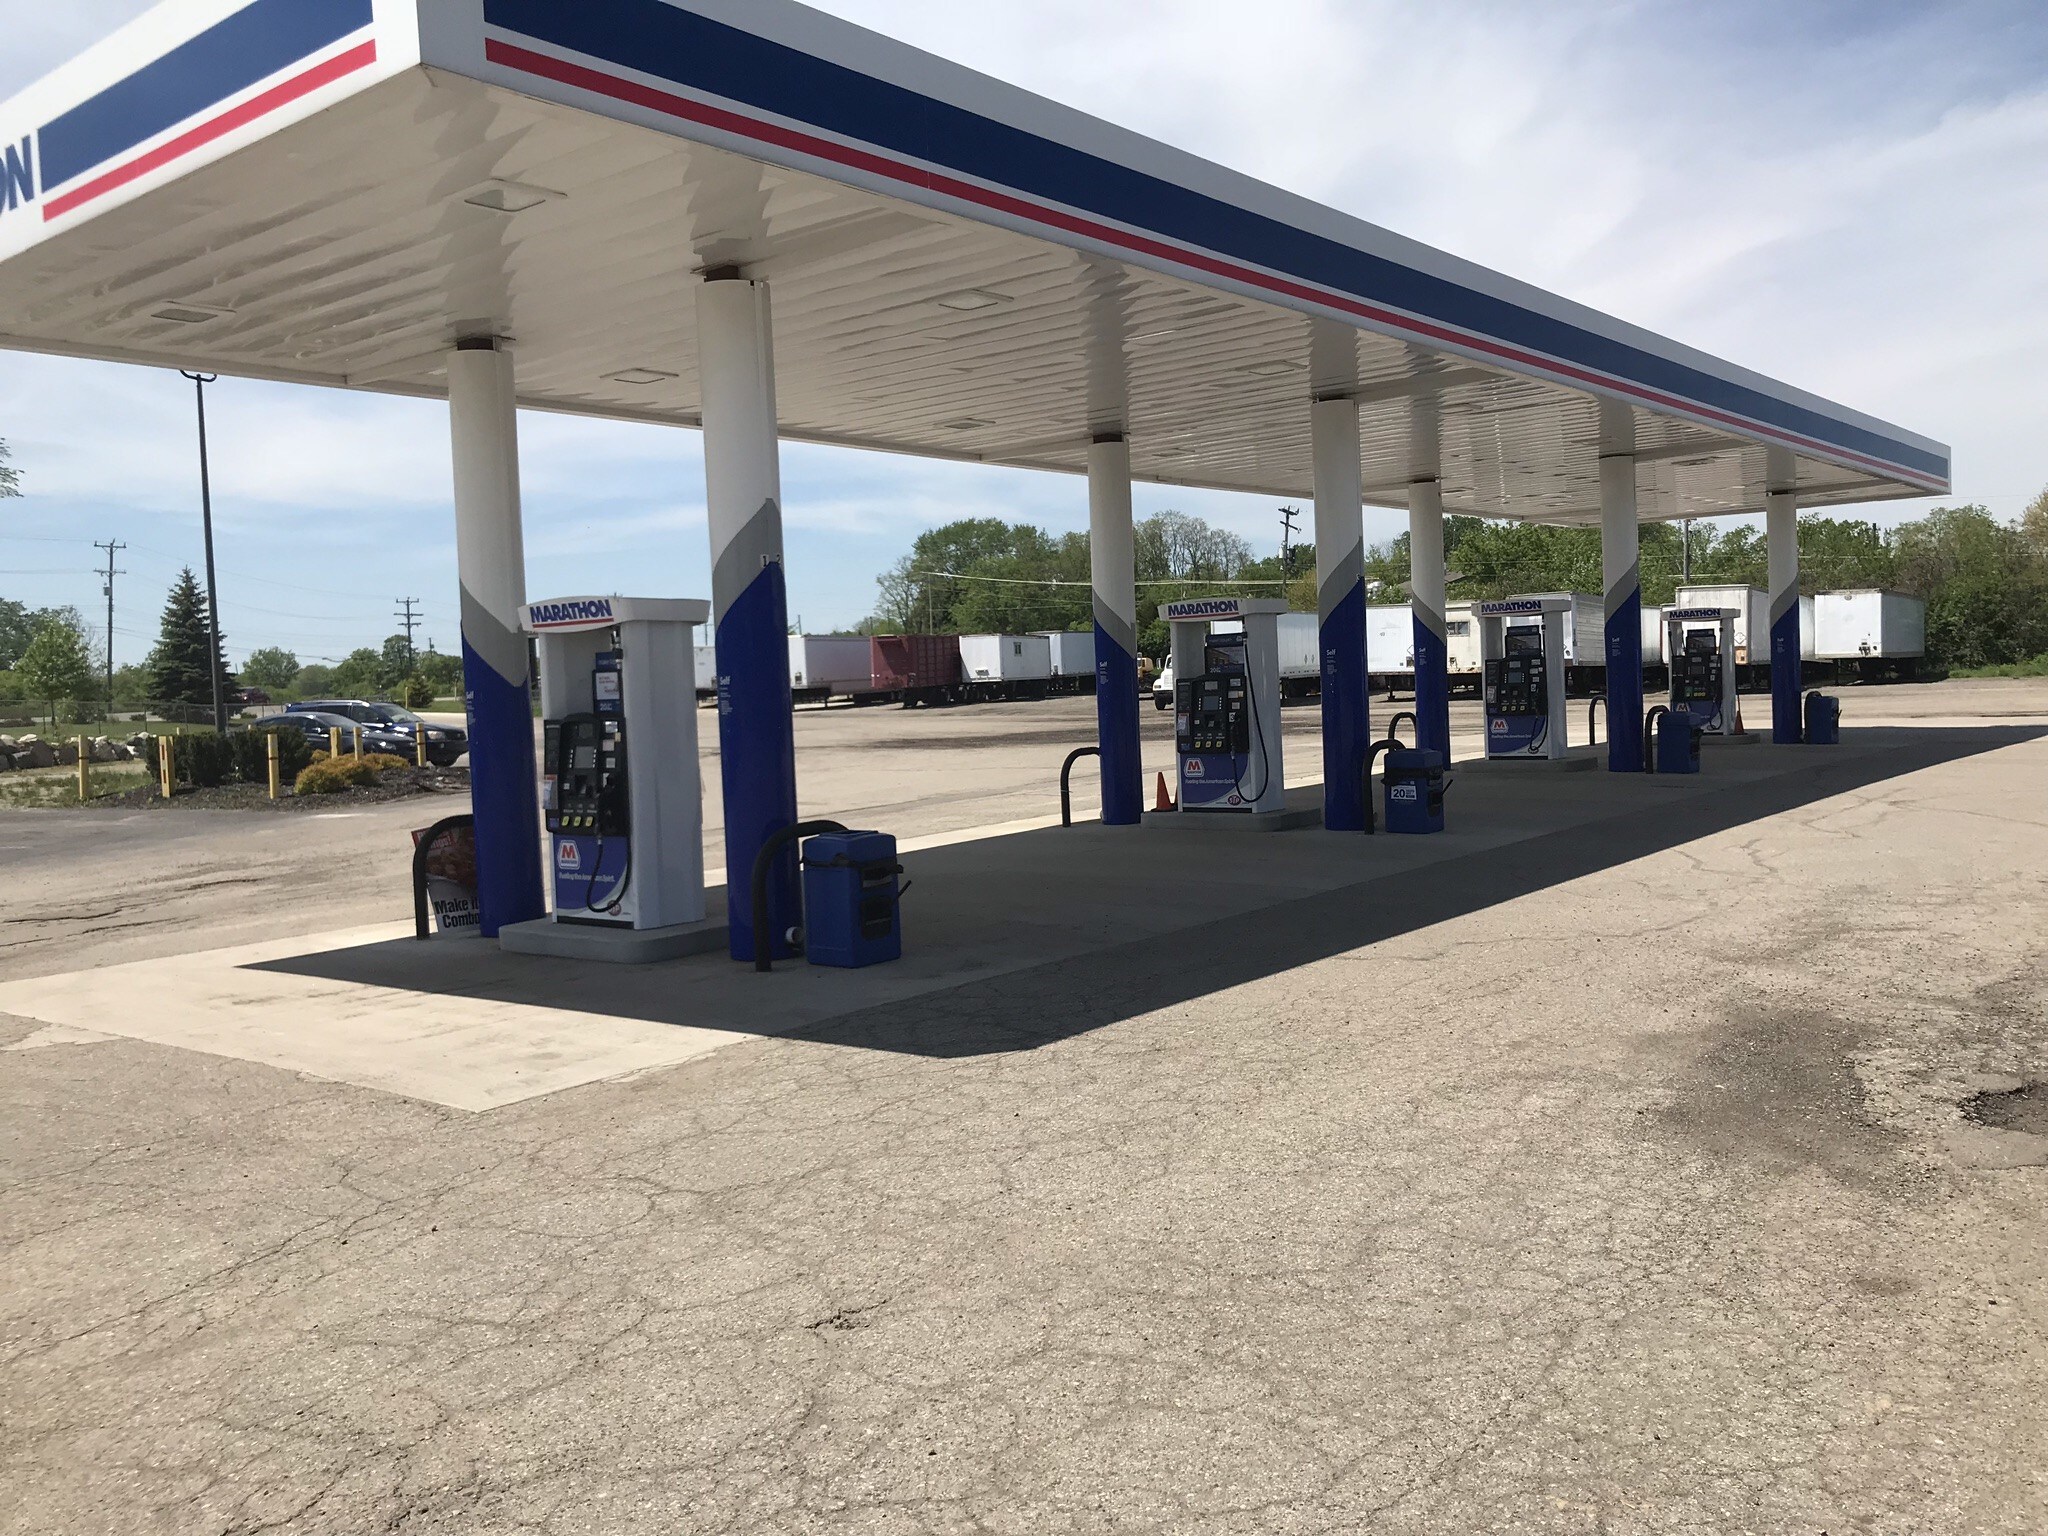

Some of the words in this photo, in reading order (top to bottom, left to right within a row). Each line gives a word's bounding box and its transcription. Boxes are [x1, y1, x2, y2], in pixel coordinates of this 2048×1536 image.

[0, 134, 34, 215] N
[529, 599, 613, 623] MARATHON
[1167, 600, 1239, 616] MARATHON
[1481, 600, 1542, 612] MARATHON
[1669, 609, 1721, 618] MARATHON
[1494, 720, 1506, 728] M
[1188, 760, 1201, 771] M
[1393, 788, 1405, 798] 20
[562, 845, 576, 859] M
[434, 898, 468, 914] Make
